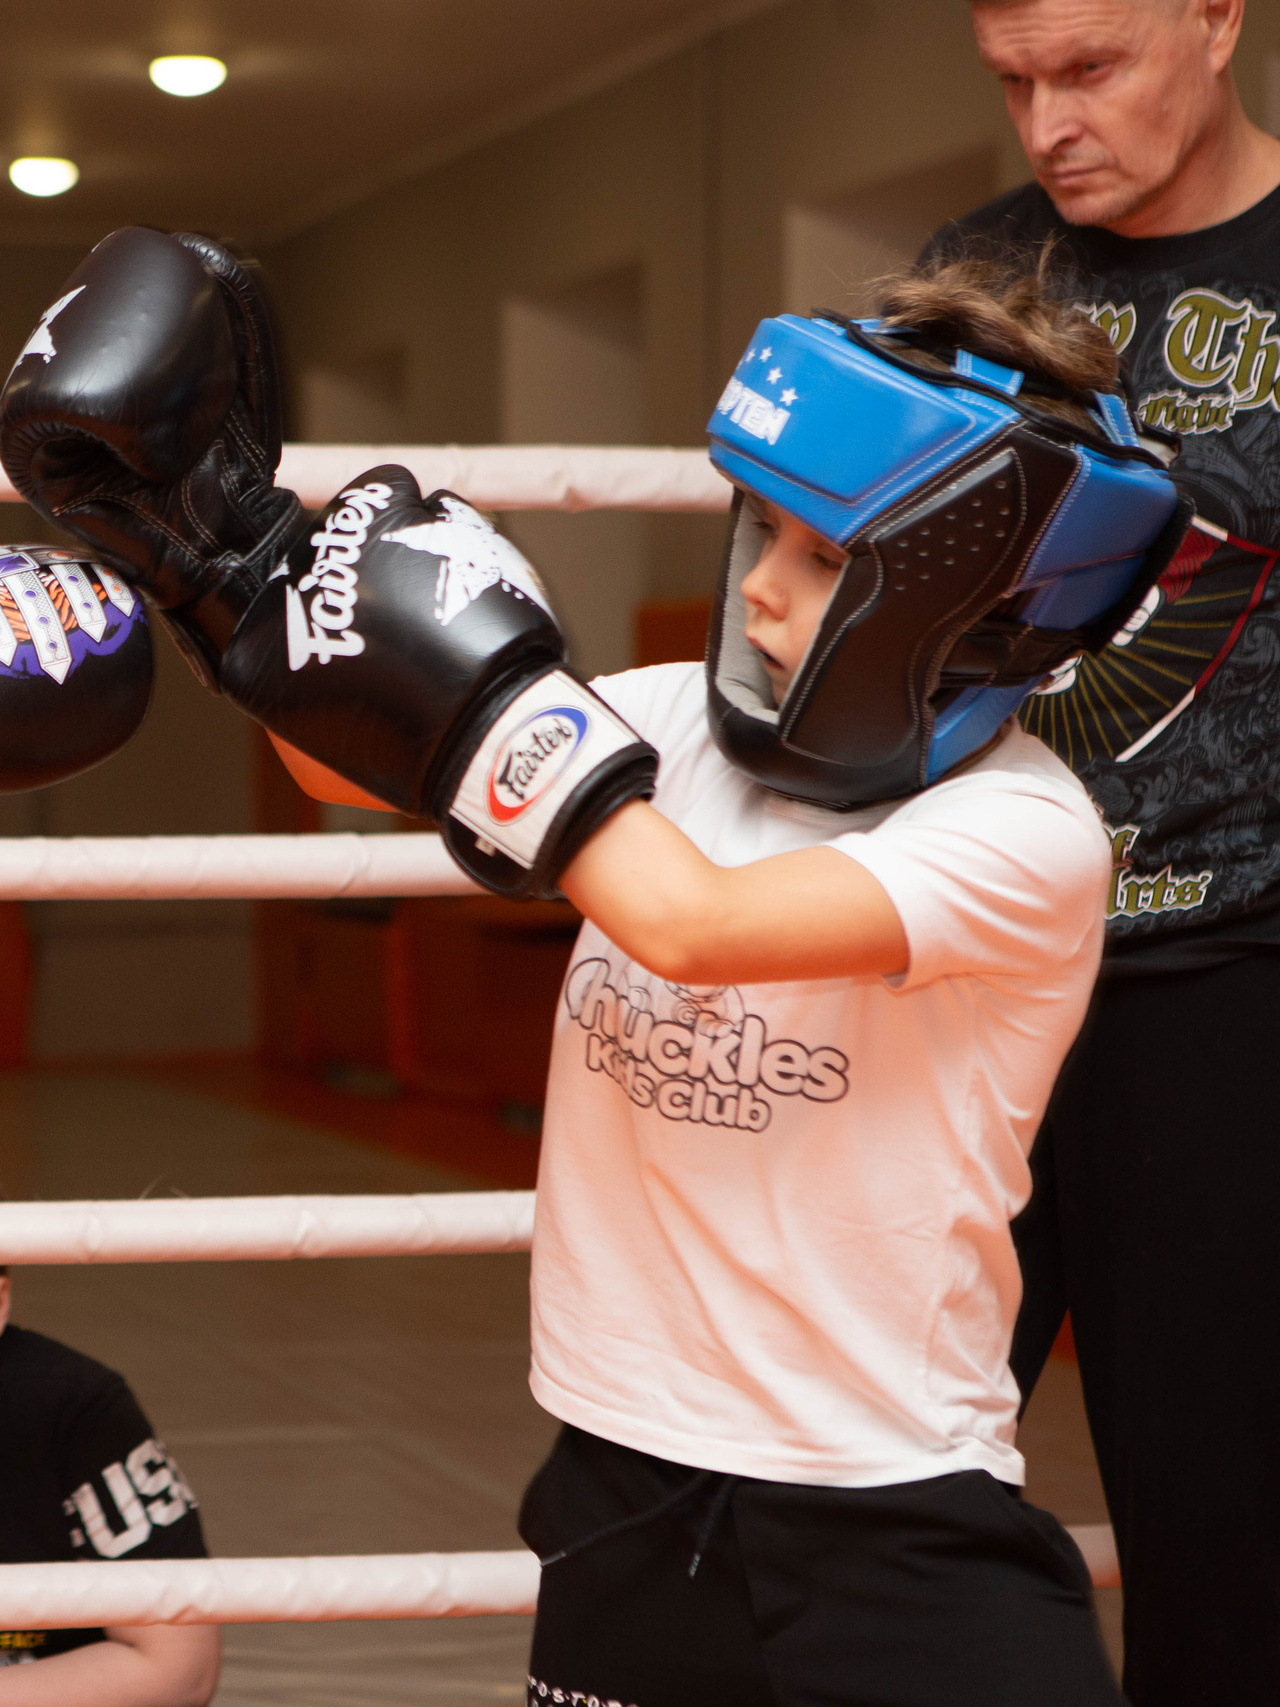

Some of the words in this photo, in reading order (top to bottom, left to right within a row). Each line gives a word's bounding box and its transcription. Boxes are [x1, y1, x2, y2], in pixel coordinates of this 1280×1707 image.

[1164, 288, 1280, 412] Th
[286, 482, 393, 672] Fairtex
[497, 717, 572, 800] Fairtex
